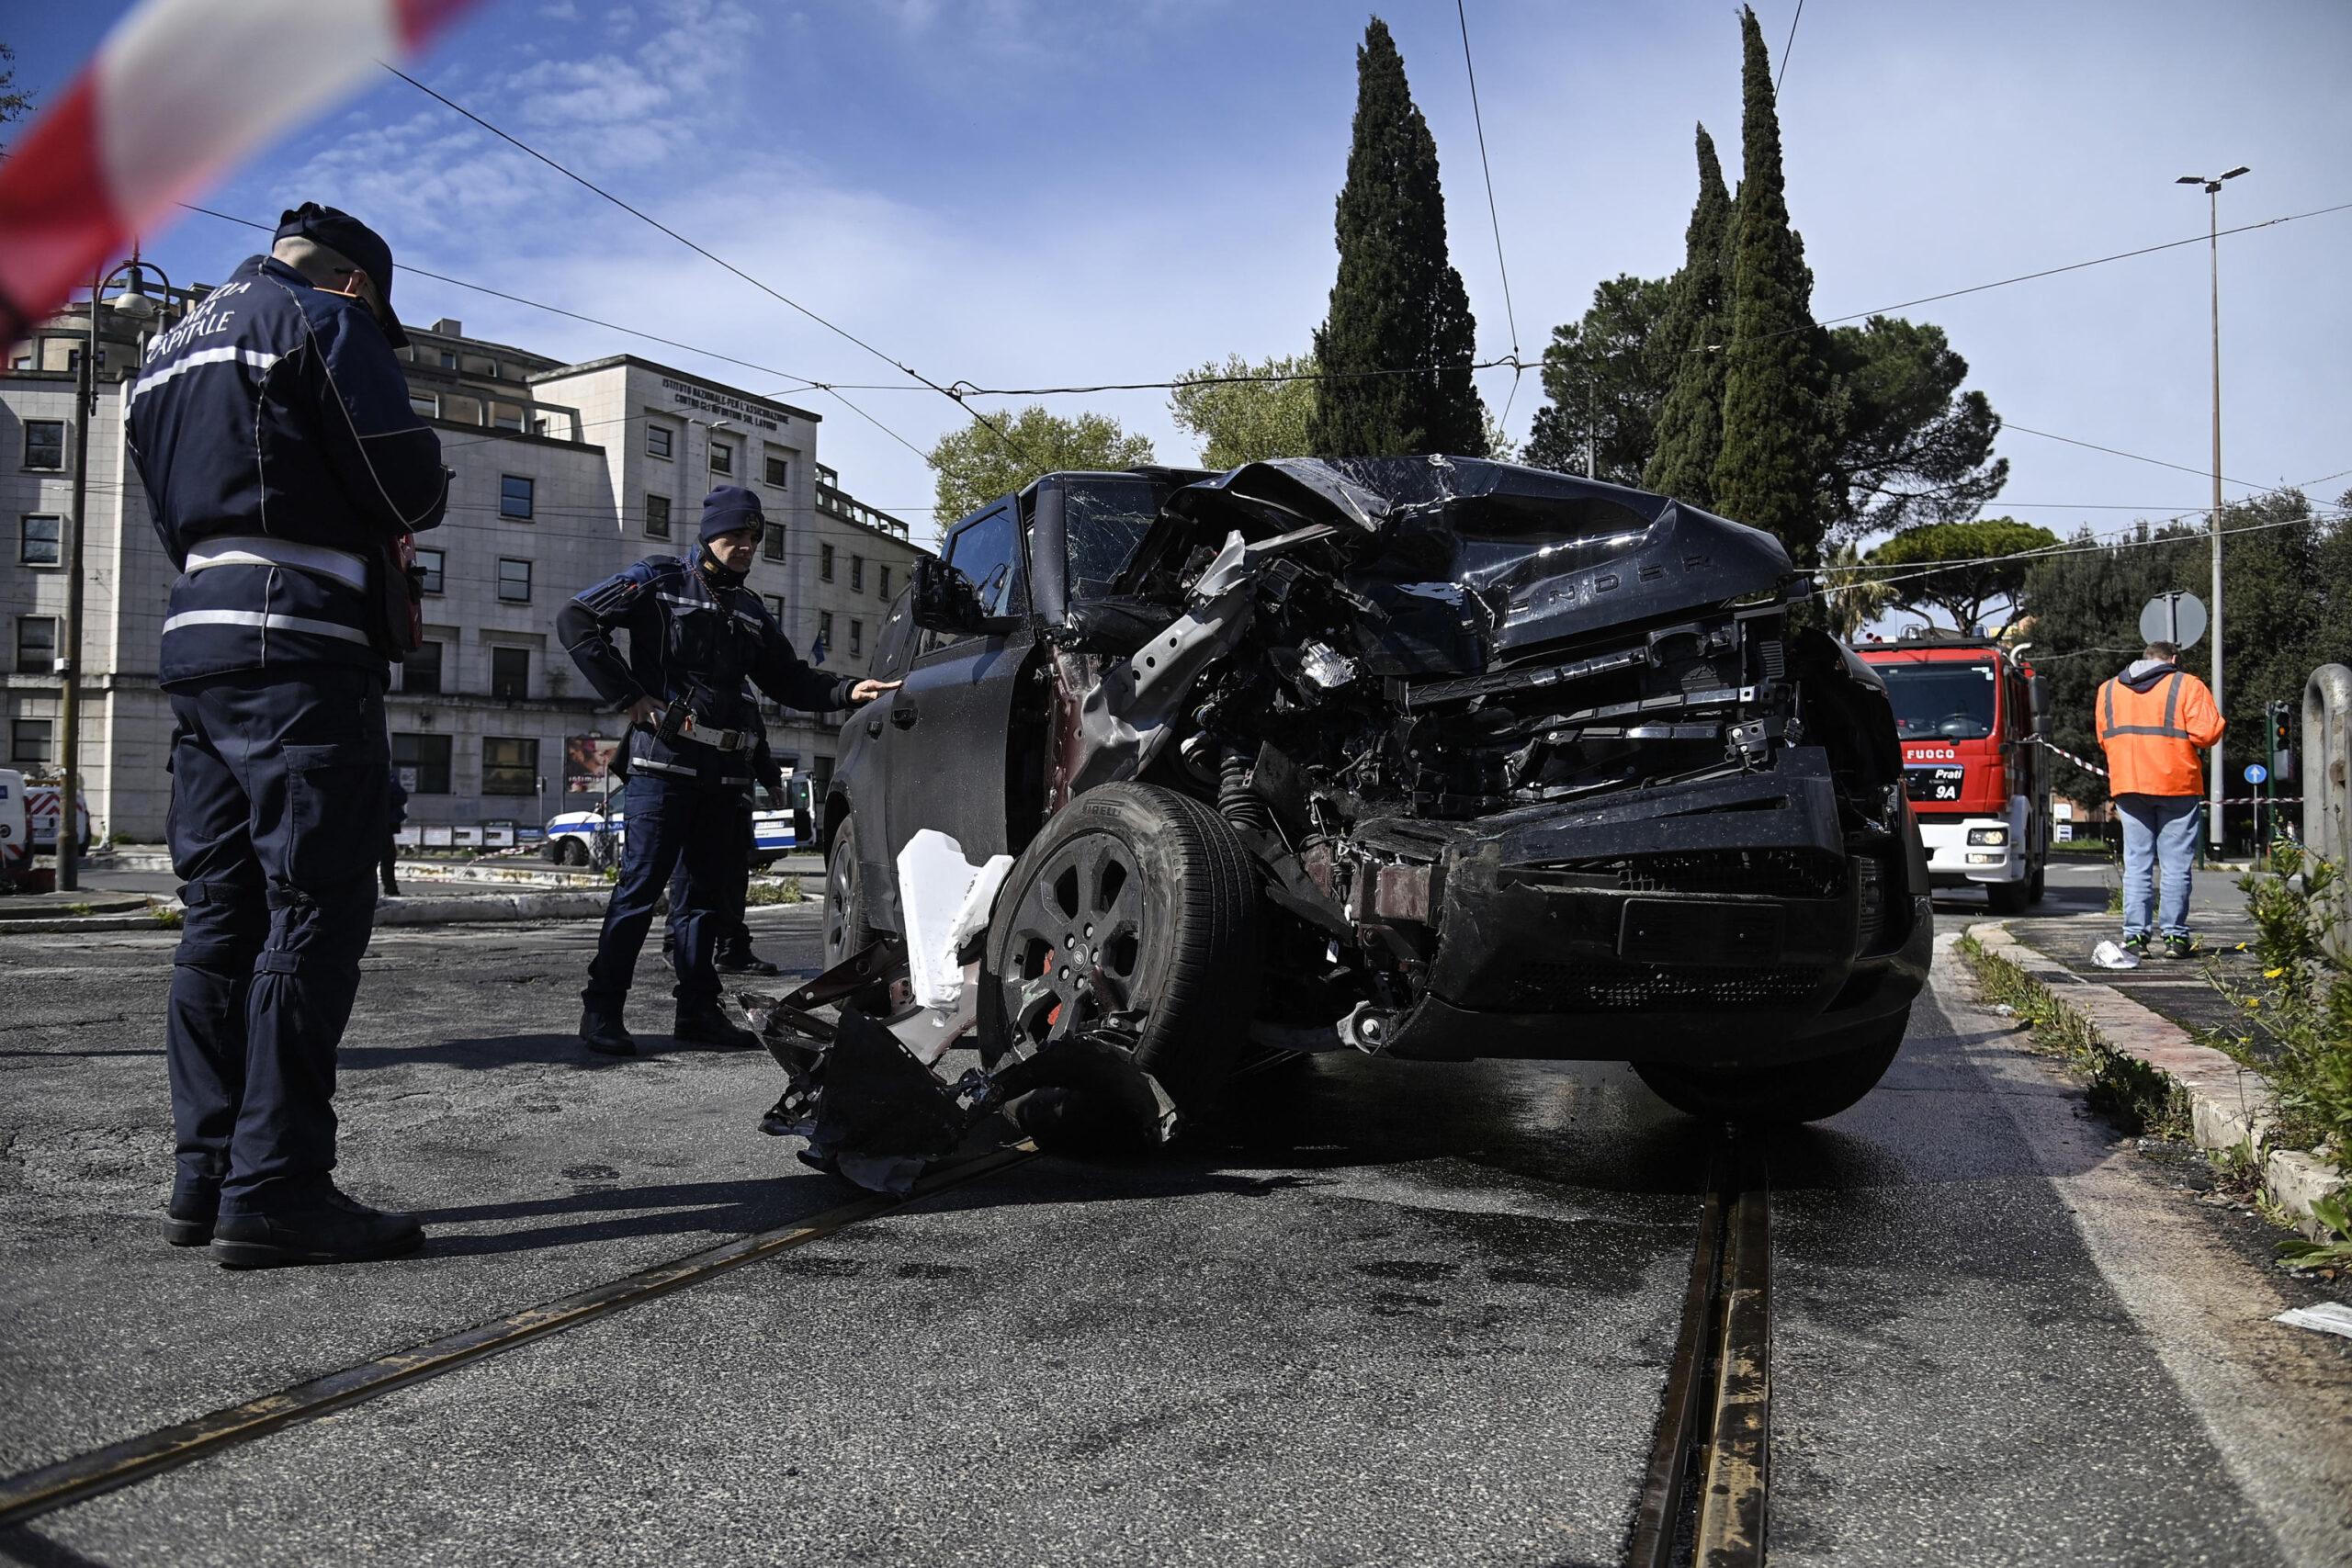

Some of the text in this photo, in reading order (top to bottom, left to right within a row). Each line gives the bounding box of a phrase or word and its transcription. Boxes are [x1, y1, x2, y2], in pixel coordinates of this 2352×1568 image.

[146, 310, 235, 364] CAPITALE
[662, 378, 692, 395] ISTITUTO
[693, 387, 726, 405] NAZIONALE
[726, 398, 740, 410] PER
[674, 393, 699, 409] CONTRO
[743, 413, 753, 425] SUL
[755, 417, 777, 432] LAVORO
[1906, 749, 1955, 760] FUOCO
[1935, 769, 1963, 780] Prati
[1935, 785, 1956, 799] 9A
